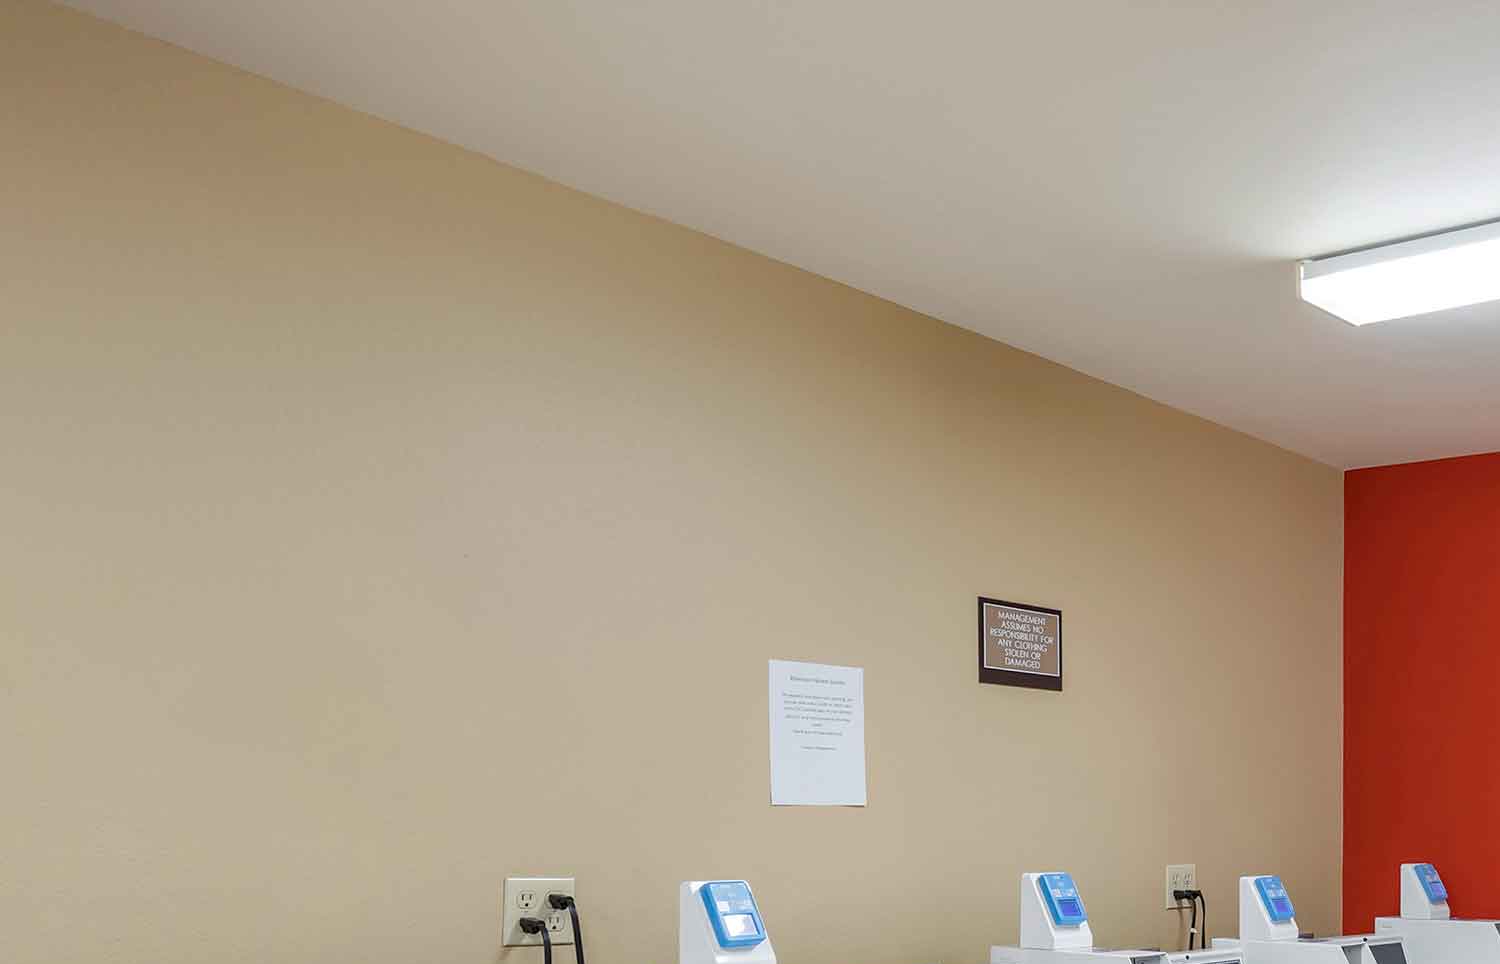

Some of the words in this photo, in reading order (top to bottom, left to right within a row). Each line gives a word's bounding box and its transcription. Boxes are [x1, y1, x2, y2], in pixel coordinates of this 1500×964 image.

[998, 610, 1045, 625] MANAGEMENT
[1001, 620, 1031, 633] ASSUMES
[1033, 625, 1044, 635] NO
[991, 627, 1038, 642] RESPONSIBILITY
[1040, 635, 1053, 645] FOR
[998, 638, 1012, 648] ANY
[1014, 640, 1047, 653] CLOTHING
[1004, 648, 1029, 659] STOLEN
[1031, 651, 1041, 661] OR
[1004, 656, 1040, 669] DAMAGED
